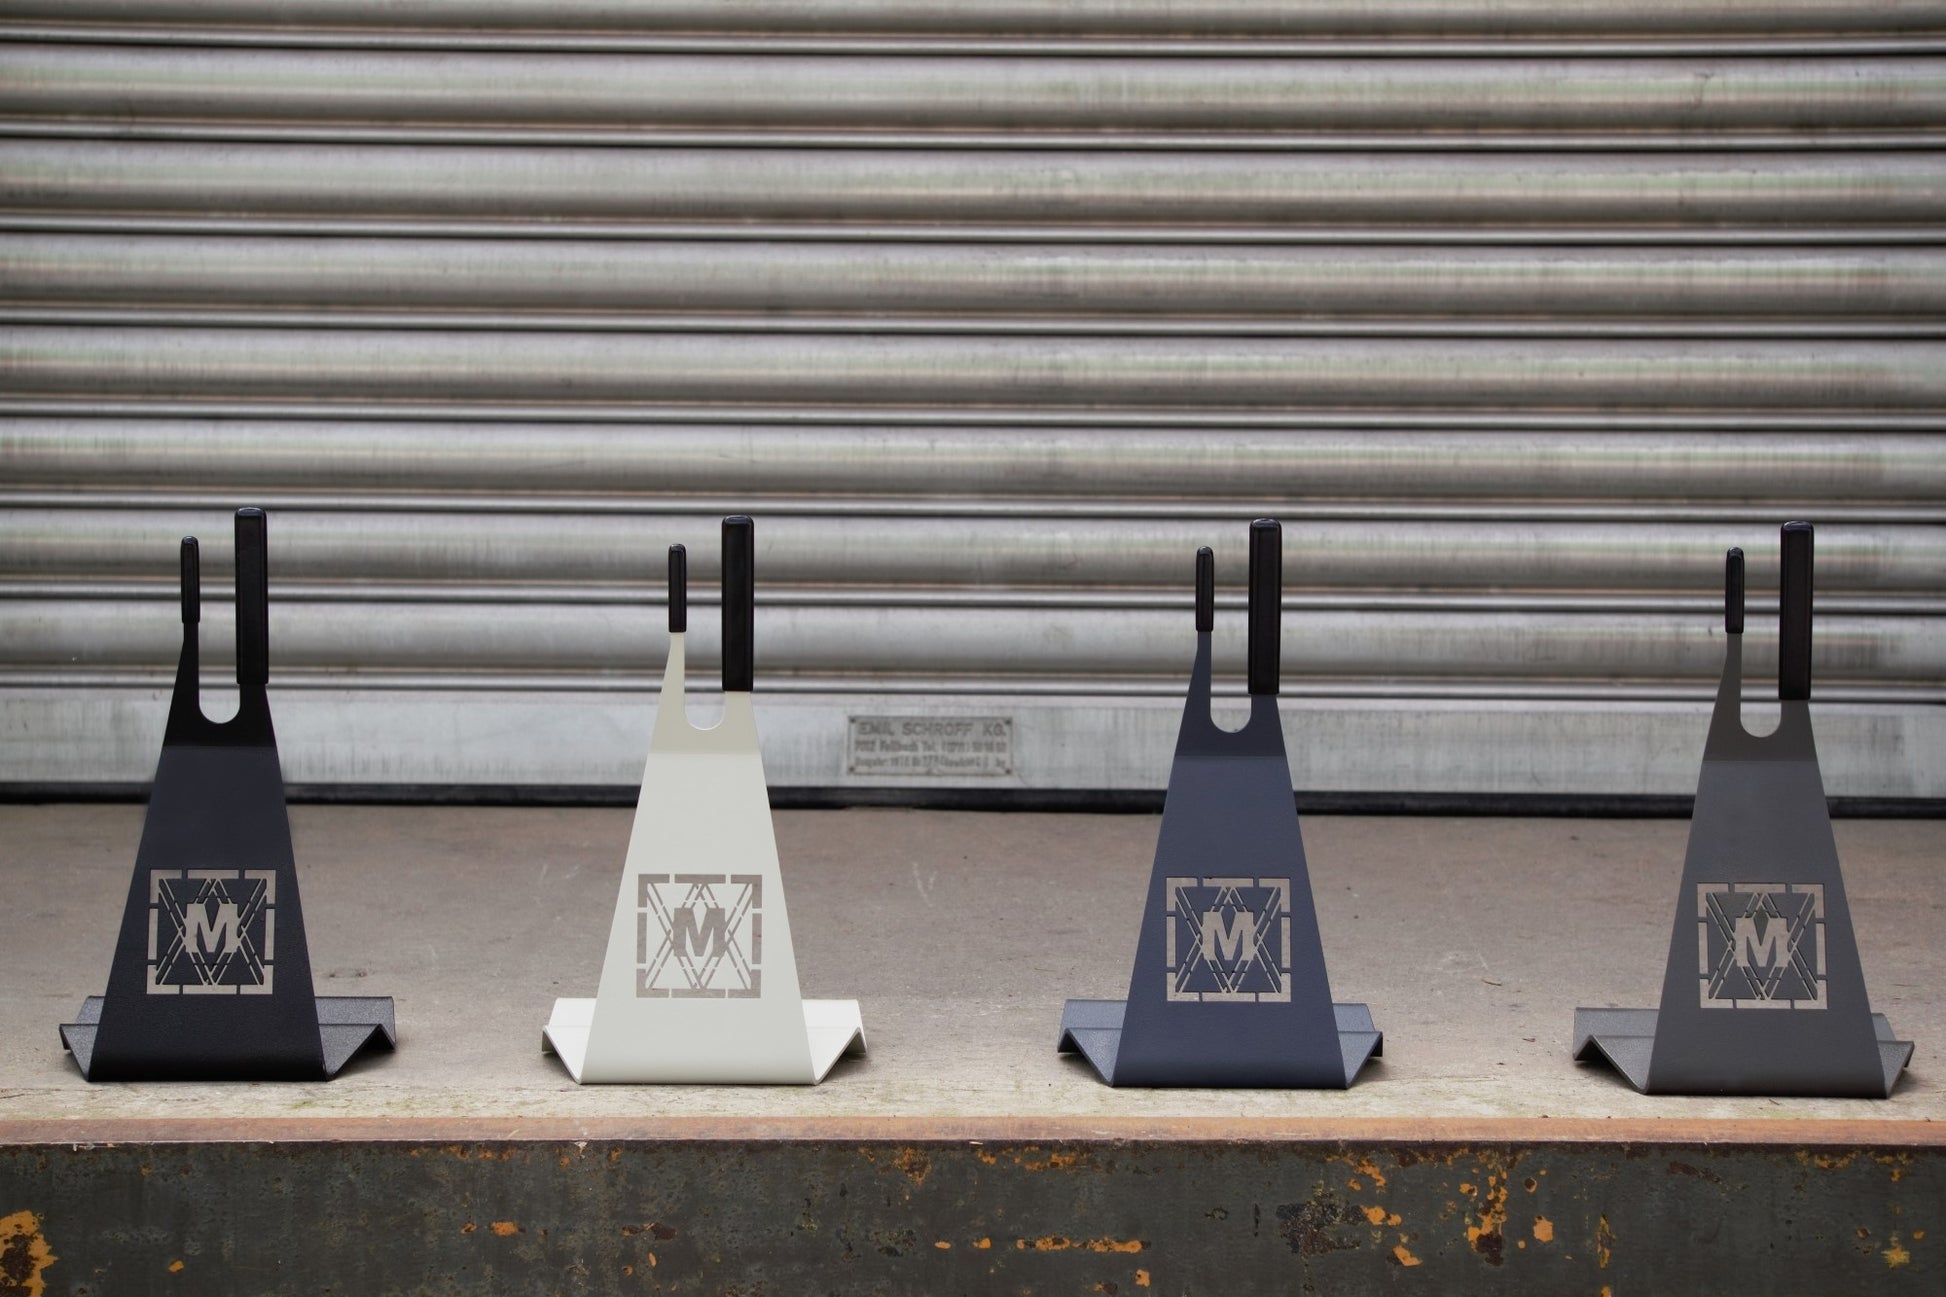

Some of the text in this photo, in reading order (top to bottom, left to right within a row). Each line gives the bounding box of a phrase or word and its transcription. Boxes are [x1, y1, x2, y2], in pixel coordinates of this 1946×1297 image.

[858, 722, 895, 736] EMIL
[902, 722, 974, 736] SCHROFF
[186, 903, 238, 953] M
[673, 907, 726, 957] M
[1202, 911, 1254, 961] M
[1735, 917, 1788, 967] M
